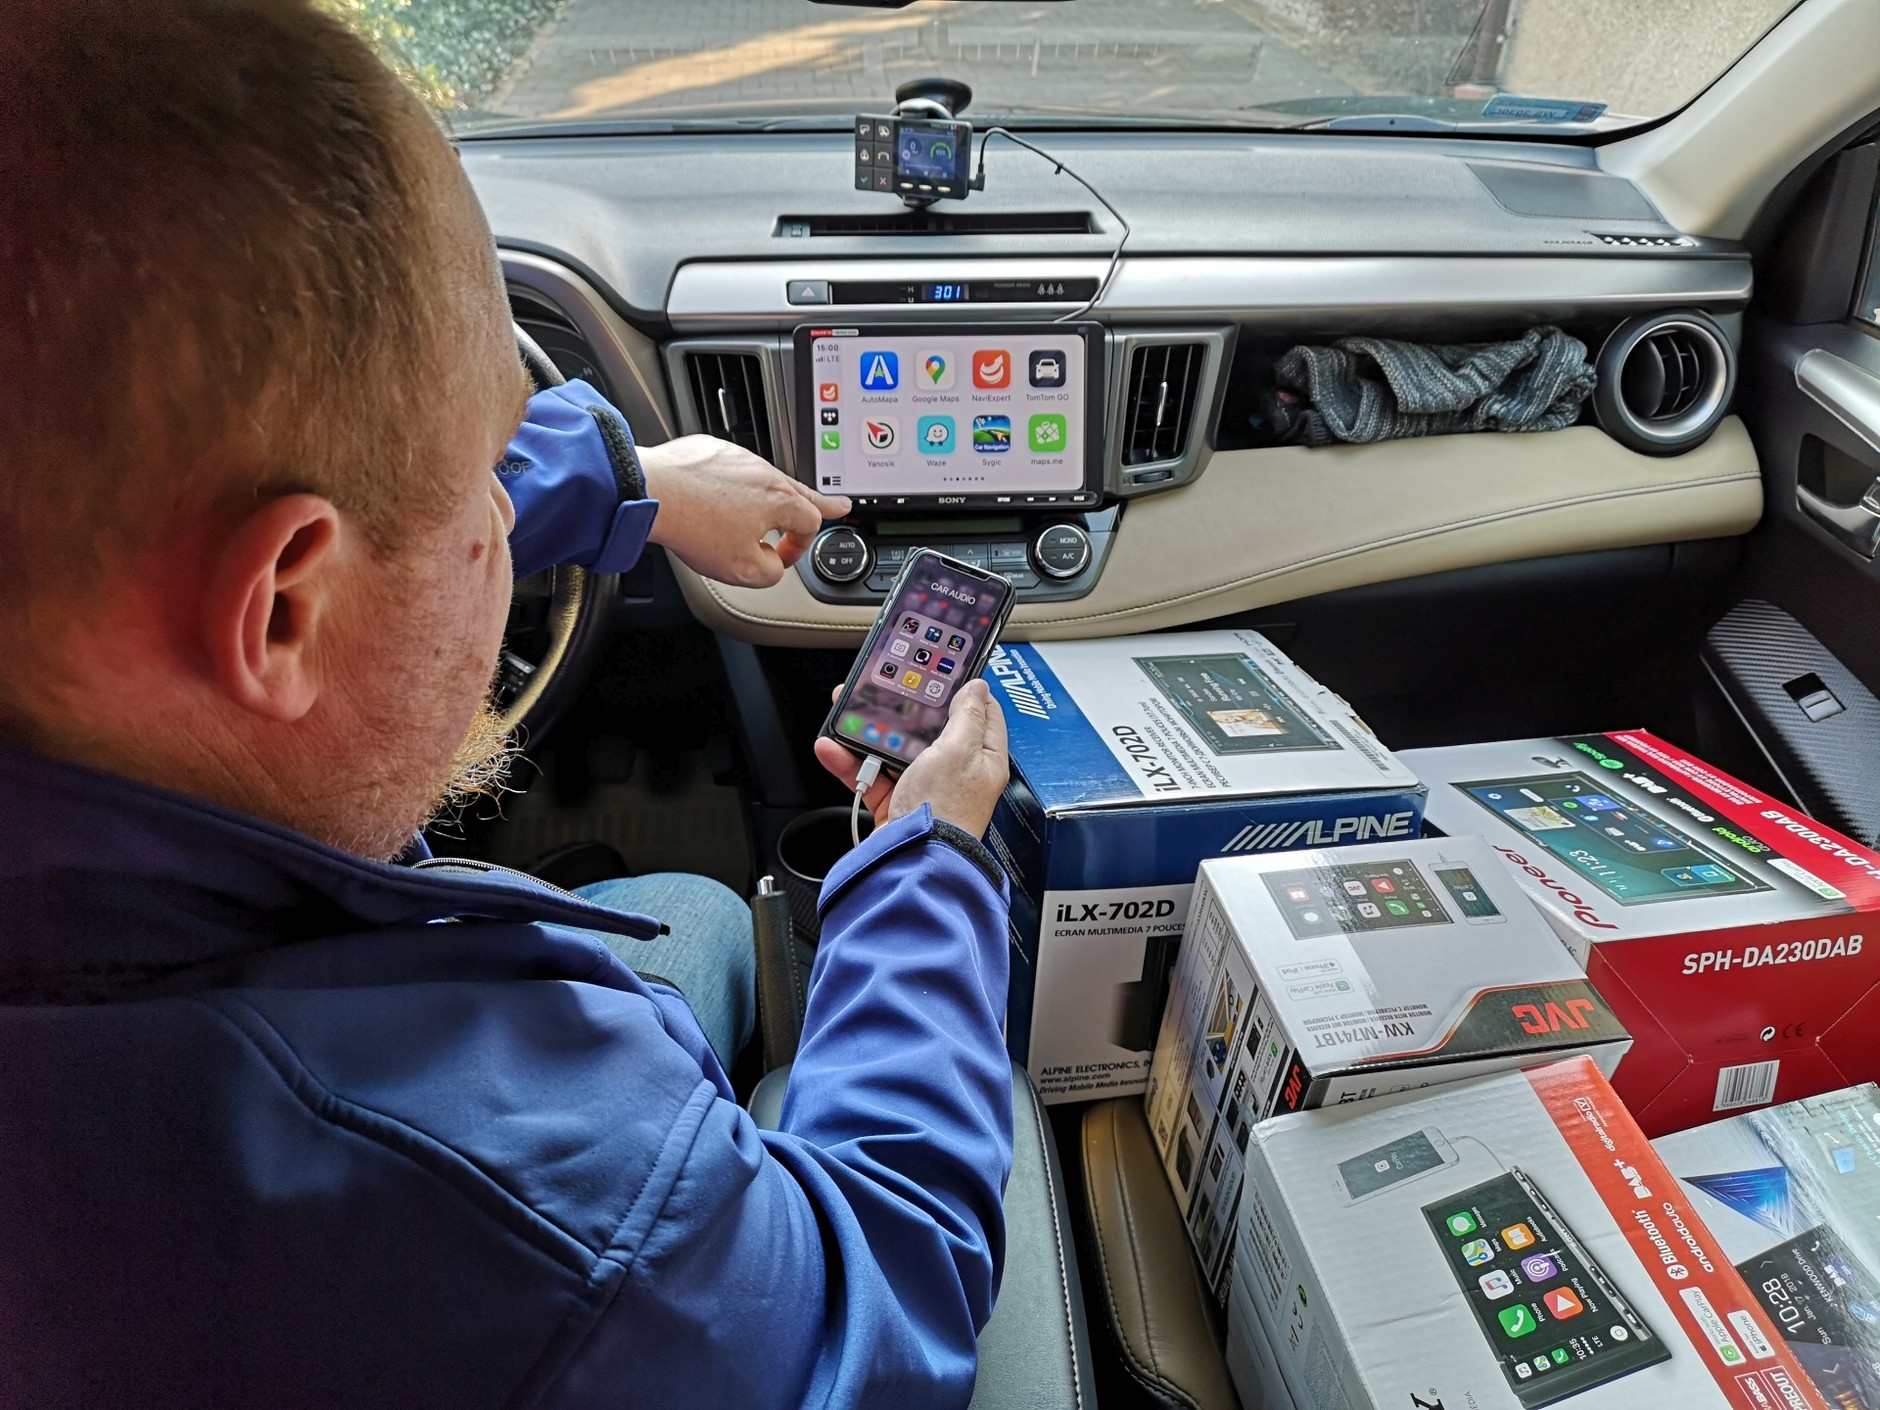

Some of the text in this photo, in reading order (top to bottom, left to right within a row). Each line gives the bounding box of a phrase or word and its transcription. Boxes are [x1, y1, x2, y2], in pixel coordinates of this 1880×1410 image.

[861, 396, 898, 405] AutoMapa
[912, 395, 960, 403] Google Maps
[972, 394, 1011, 403] NaviExpert
[1026, 393, 1069, 401] TomTom GO
[974, 443, 1010, 452] Car Navigation
[495, 461, 530, 477] OOF
[867, 459, 895, 468] Yanosik
[926, 459, 946, 467] Waze
[982, 458, 1002, 467] Sygic
[1031, 458, 1063, 466] maps.me
[1062, 552, 1075, 560] A/C
[930, 582, 976, 605] CAR AUDIO
[1144, 726, 1167, 749] RECEIVER
[1112, 725, 1181, 792] iLX-702D
[1162, 747, 1184, 772] MONITOR
[1172, 739, 1202, 776] MULTIMEDIA
[1572, 741, 1606, 760] Spotify
[1199, 775, 1216, 789] ECRAN
[1622, 772, 1668, 793] DAB+
[1667, 797, 1702, 816] Bluetooth
[1285, 811, 1414, 846] ALPINE
[1711, 826, 1761, 853] android
[1742, 835, 1770, 852] auto
[1760, 810, 1880, 880] H-DA230DAB
[1569, 849, 1616, 877] 11:23
[1492, 845, 1620, 930] Pioneer
[1056, 899, 1175, 923] iLX-702D
[1054, 928, 1086, 937] ECRAN
[1087, 925, 1143, 936] MULTIMEDIA
[1145, 925, 1151, 933] 7
[1681, 934, 1864, 976] SPH-DA230DAB
[1282, 967, 1299, 975] iPod
[1290, 982, 1334, 994] Apple CarPlay
[1345, 1017, 1368, 1026] MONITOR
[1371, 1014, 1393, 1022] RECEIVER
[1393, 1012, 1409, 1020] WITH
[1410, 1010, 1432, 1019] MONITOR
[1512, 998, 1595, 1034] JVC
[1307, 1022, 1331, 1032] RECEIVER
[1314, 1021, 1415, 1049] KW-M741BT
[1039, 1072, 1111, 1084] www.alpine.com
[1041, 1066, 1073, 1076] ALPINE
[1075, 1061, 1141, 1073] ELECTRONICS,
[1039, 1084, 1067, 1094] Driving
[1068, 1082, 1094, 1091] Mobile
[1095, 1080, 1118, 1089] Media
[1284, 1064, 1303, 1110] JVC
[1585, 1111, 1616, 1152] digitalradio
[1613, 1158, 1653, 1199] DAB+
[1472, 1206, 1487, 1228] Messages
[1526, 1216, 1548, 1242] Audiobooks
[1561, 1228, 1578, 1247] SONY
[1634, 1209, 1679, 1265] Bluetooth
[1662, 1202, 1714, 1273] androidauto
[1491, 1238, 1502, 1252] Maps
[1550, 1248, 1569, 1272] Podcasts
[1509, 1269, 1522, 1285] Music
[1780, 1273, 1798, 1293] 2018
[1791, 1248, 1834, 1303] KENWOOD Drive
[1824, 1264, 1846, 1287] DAB
[1571, 1277, 1598, 1313] Now Playing
[1531, 1302, 1545, 1322] Phone
[1762, 1278, 1806, 1334] 10:28
[1803, 1305, 1817, 1321] Jan.
[1691, 1290, 1729, 1343] Apple CarPlay
[1740, 1315, 1763, 1346] iPhone
[1817, 1326, 1832, 1345] Sun
[1569, 1338, 1587, 1360] 10:35
[1591, 1335, 1604, 1348] LTE
